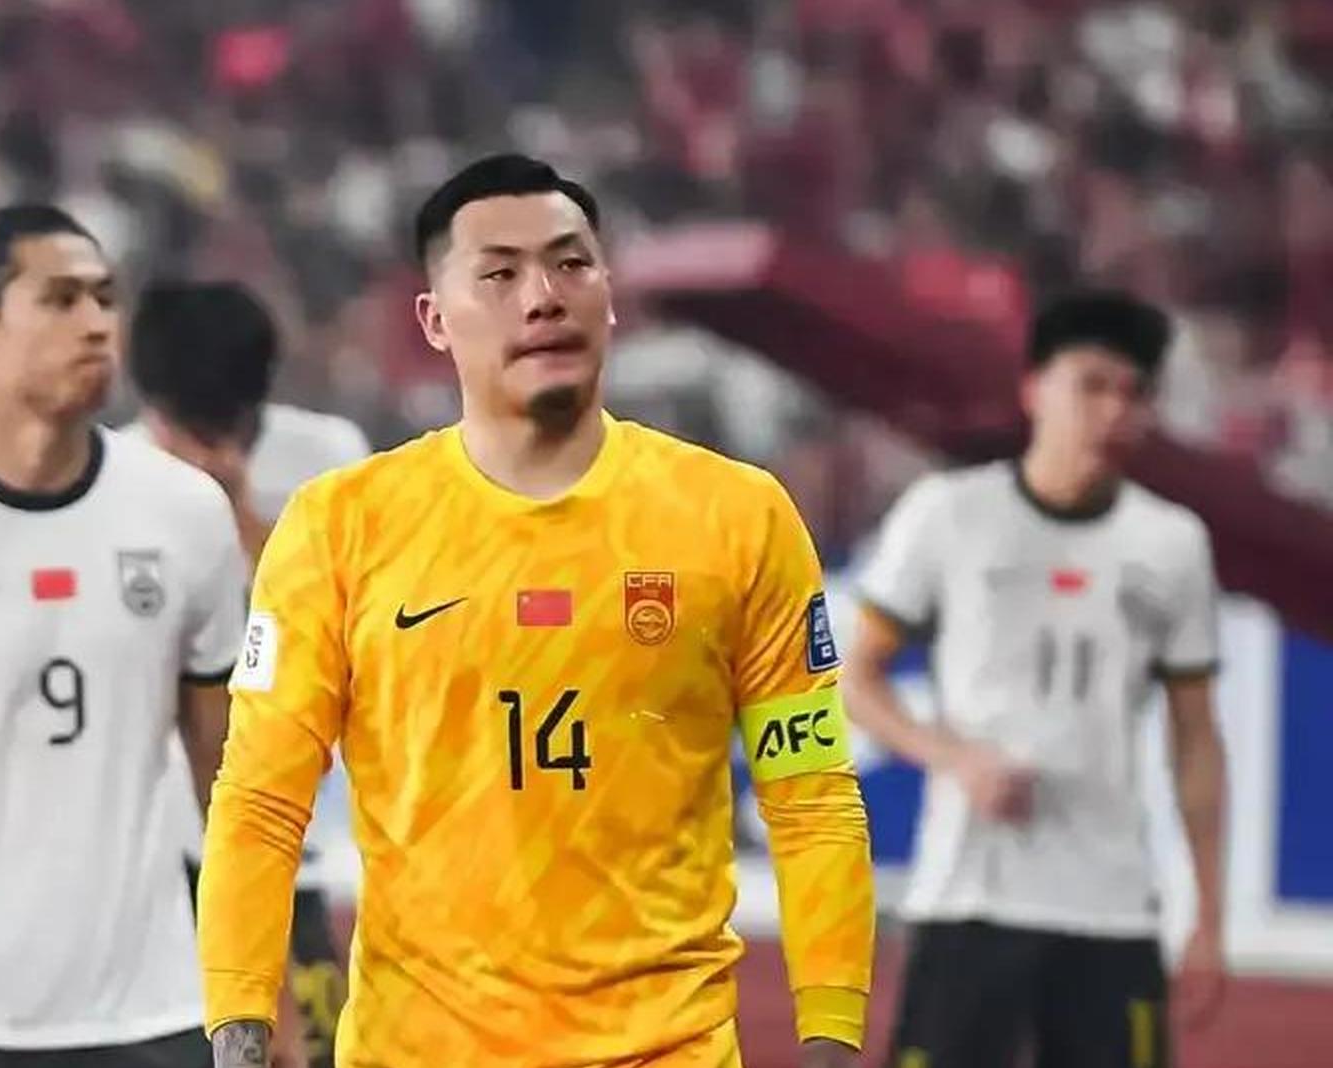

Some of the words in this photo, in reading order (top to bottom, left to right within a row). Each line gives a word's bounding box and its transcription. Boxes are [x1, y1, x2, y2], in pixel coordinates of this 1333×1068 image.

[627, 573, 672, 588] CFA
[40, 658, 85, 744] 9
[1034, 624, 1097, 702] 11
[498, 689, 592, 790] 14
[756, 709, 836, 761] AFC
